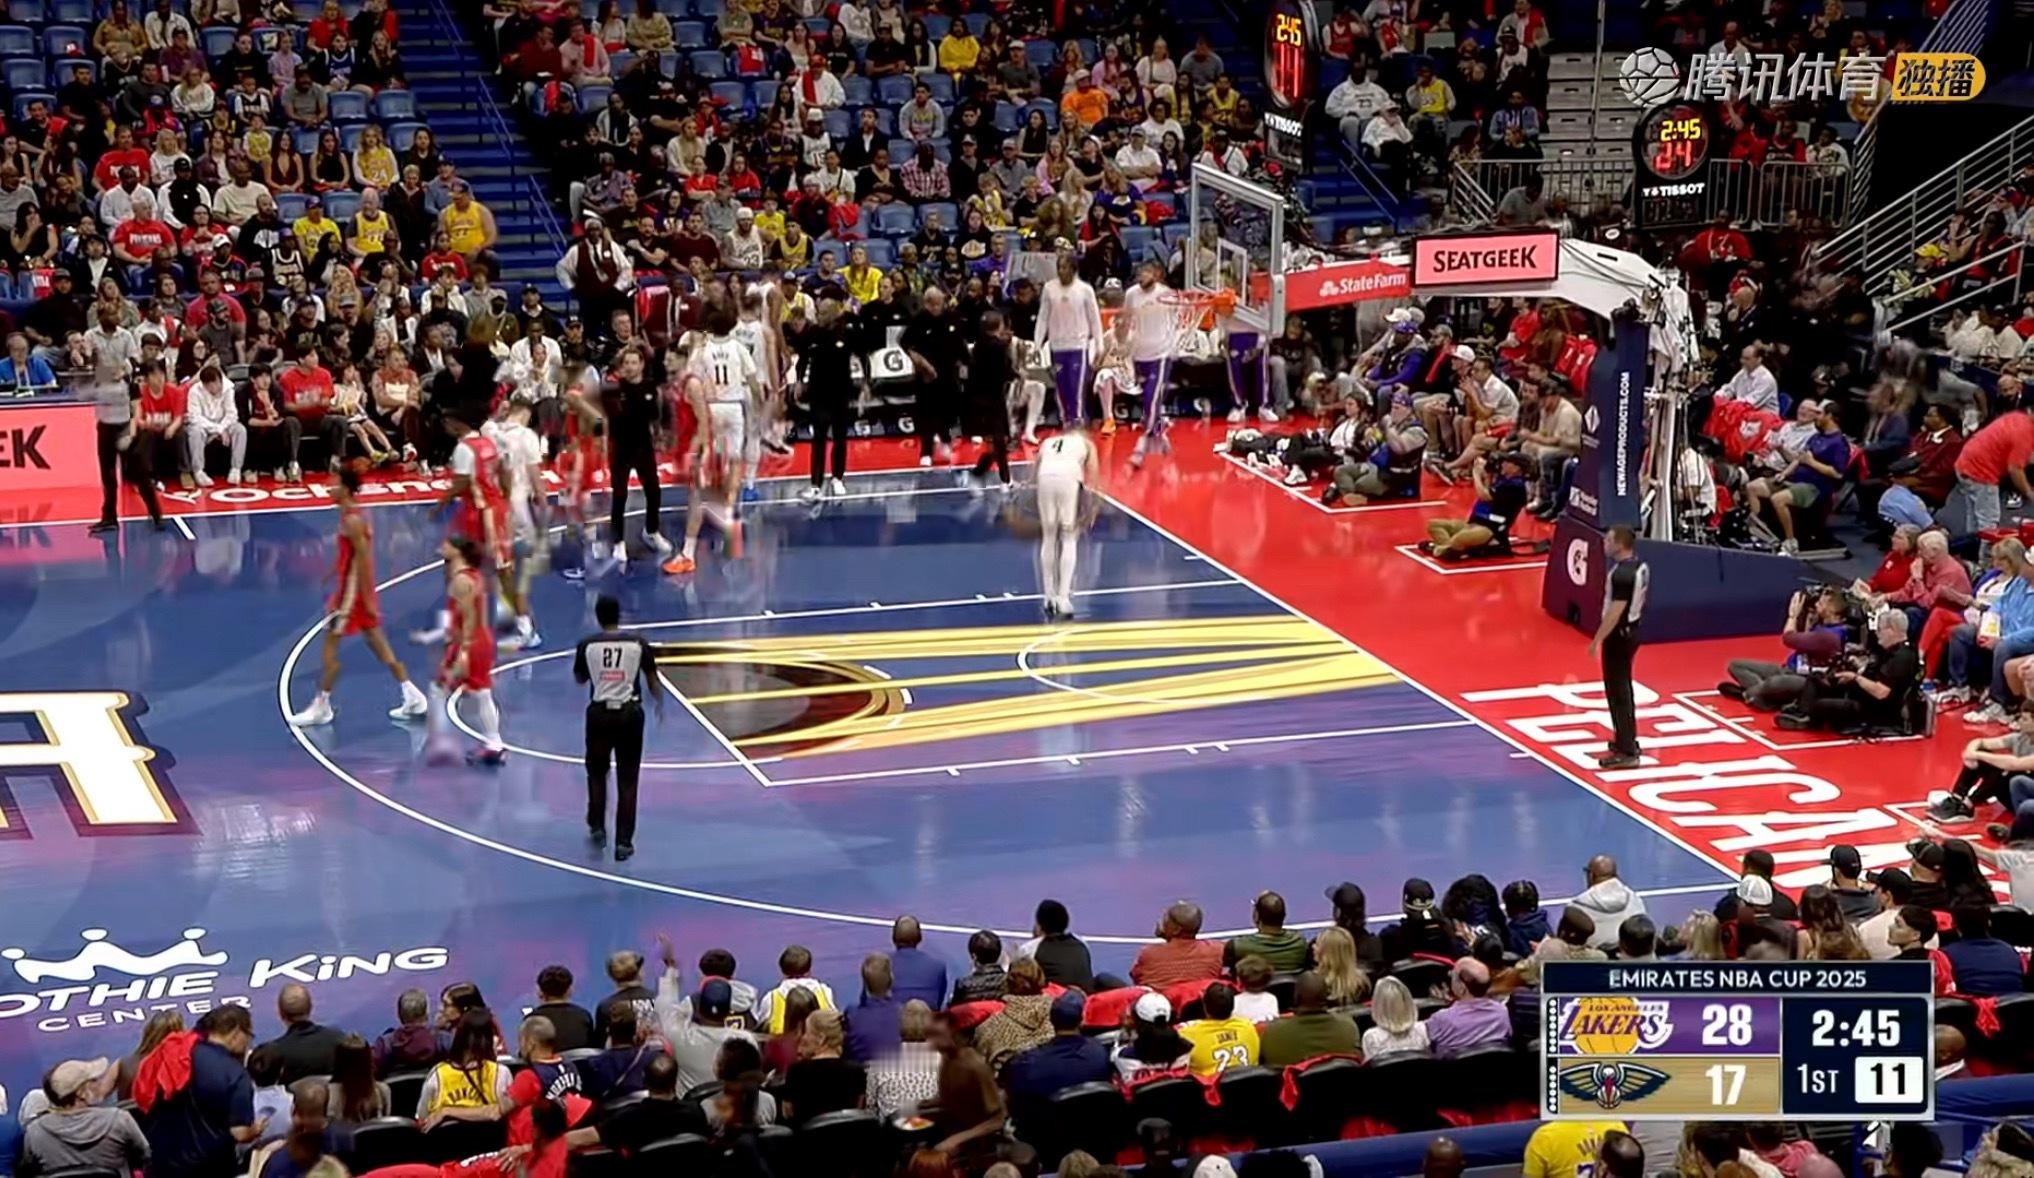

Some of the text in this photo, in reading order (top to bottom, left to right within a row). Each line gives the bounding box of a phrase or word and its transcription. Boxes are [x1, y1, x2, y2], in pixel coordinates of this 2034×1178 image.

[1660, 118, 1701, 142] 2:45
[1660, 182, 1705, 197] TISSOT
[1432, 244, 1538, 273] SEATGEEK
[714, 363, 729, 386] 11
[1617, 371, 1631, 497] NEWAGEPRODUCTS.COM
